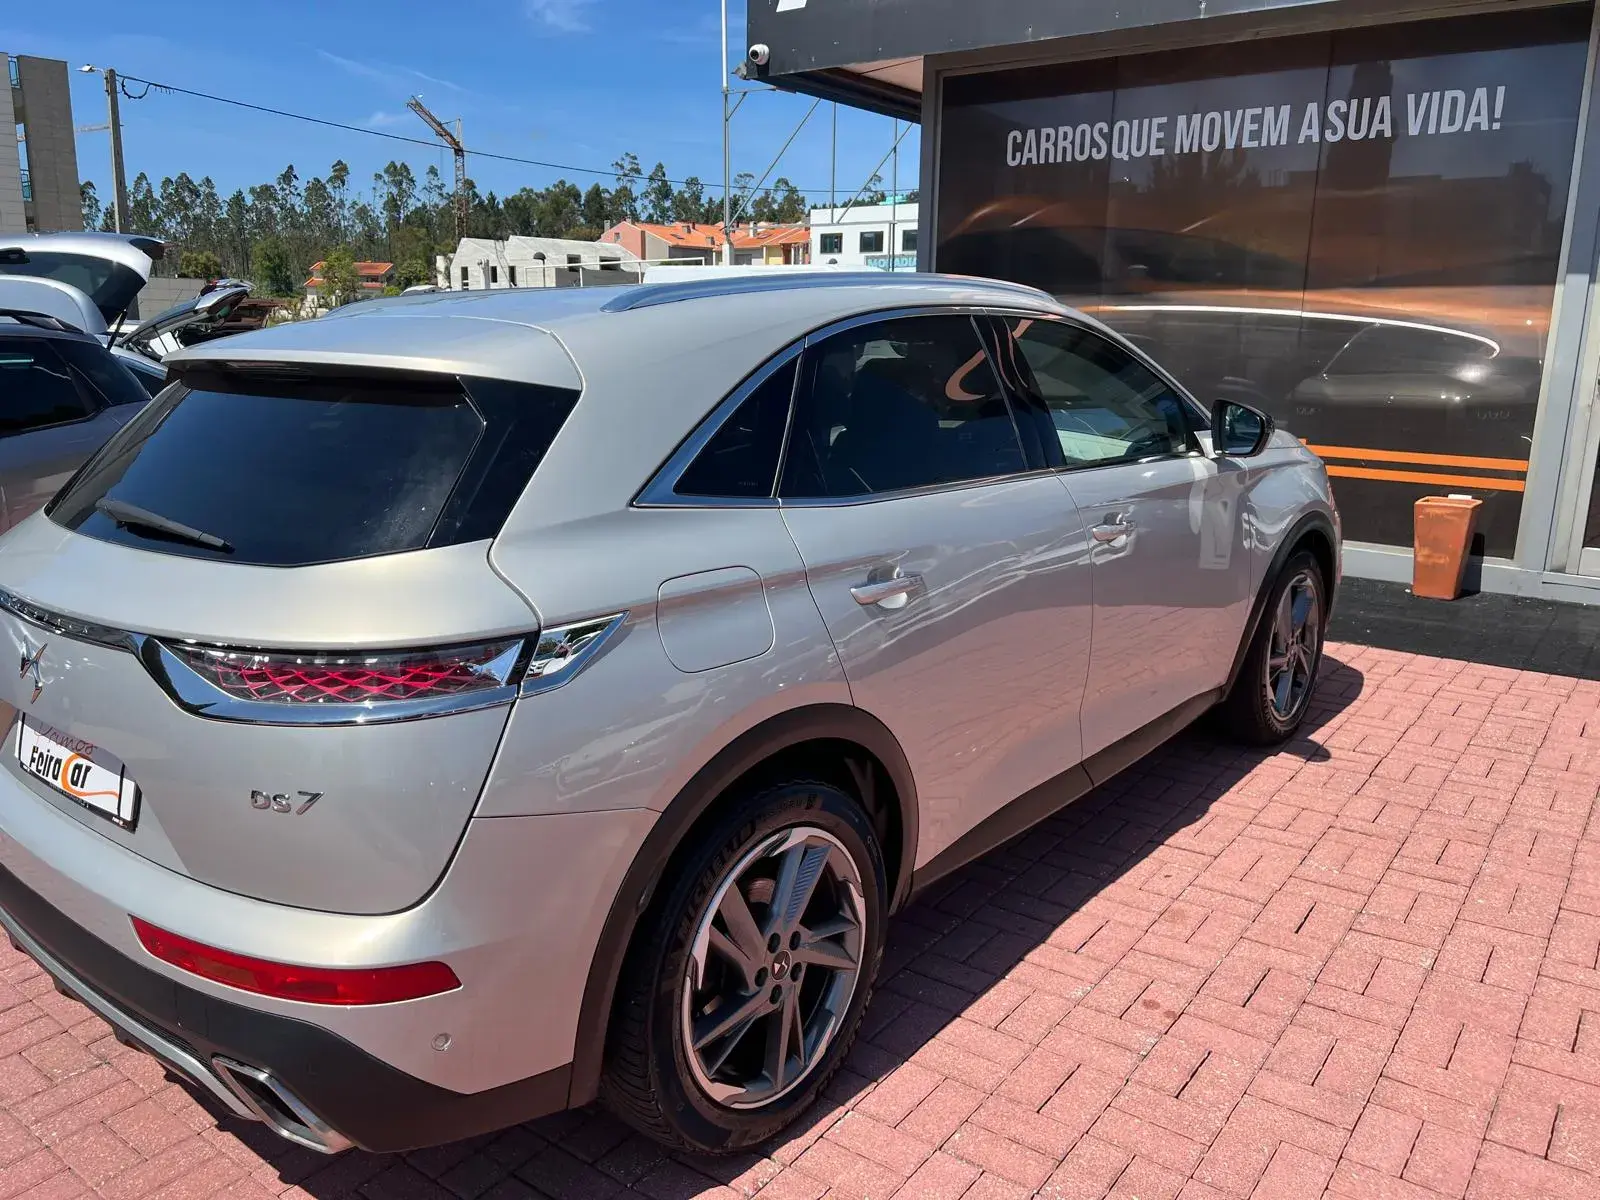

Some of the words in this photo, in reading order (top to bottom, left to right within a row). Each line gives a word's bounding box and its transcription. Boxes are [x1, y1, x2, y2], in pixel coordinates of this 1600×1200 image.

[1006, 121, 1109, 167] CARROS
[1111, 116, 1168, 161] QUE
[1174, 104, 1291, 154] MOVEM
[1406, 85, 1506, 137] VIDA!
[29, 745, 94, 797] FeiraCar
